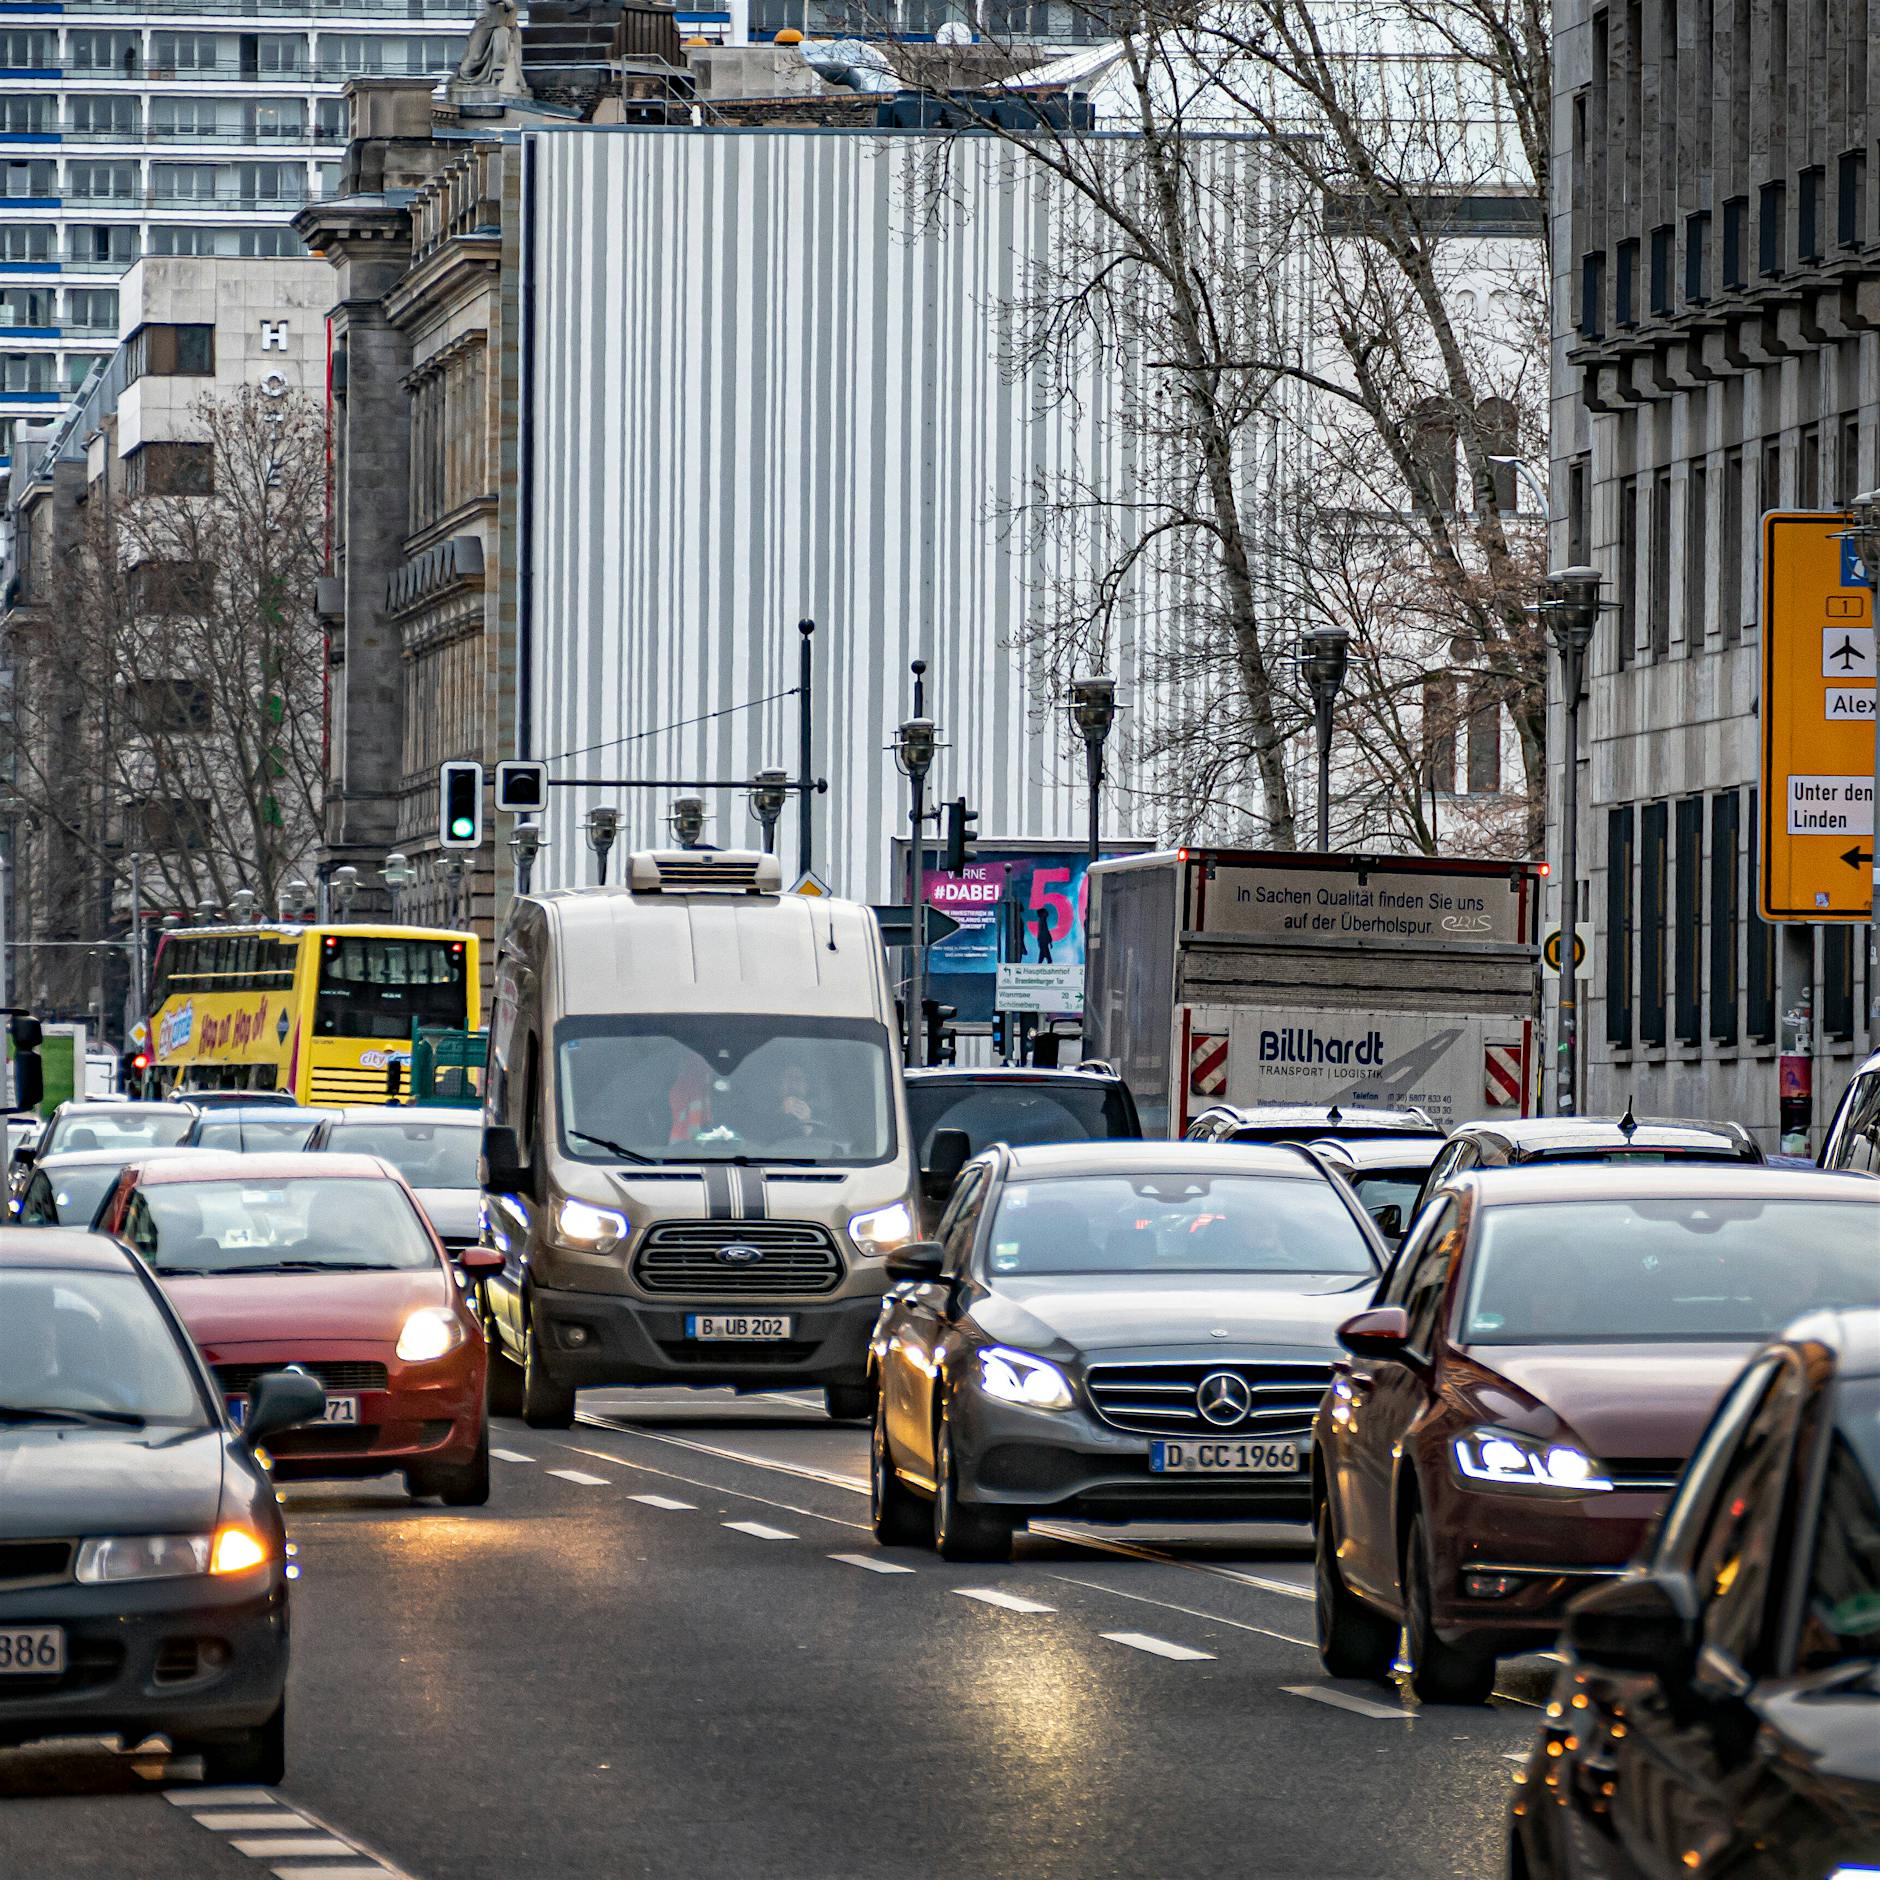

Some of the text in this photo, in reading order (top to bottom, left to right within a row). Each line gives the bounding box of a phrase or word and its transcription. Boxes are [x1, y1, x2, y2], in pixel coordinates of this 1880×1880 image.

[1842, 600, 1848, 614] 1
[1794, 782, 1873, 801] Unter den
[1794, 810, 1847, 828] Linden
[947, 868, 987, 880] VRNE
[934, 884, 1000, 901] #DABEI
[1237, 885, 1485, 911] In Sachen Qualität finden Sie uns
[1284, 911, 1434, 937] auf der Überholspur.
[1023, 967, 1071, 976] Hauptbahnhof
[999, 1000, 1040, 1010] Schöneberg
[199, 994, 268, 1058] Hop on Hop off
[1259, 1028, 1384, 1066] Billhardt
[361, 1053, 385, 1067] city
[1259, 1064, 1383, 1080] TRANSPORT LOGISTIK
[1352, 1091, 1379, 1101] Telefon
[702, 1319, 783, 1336] B UB 202
[1167, 1445, 1183, 1468] D
[1235, 1445, 1295, 1468] 1966
